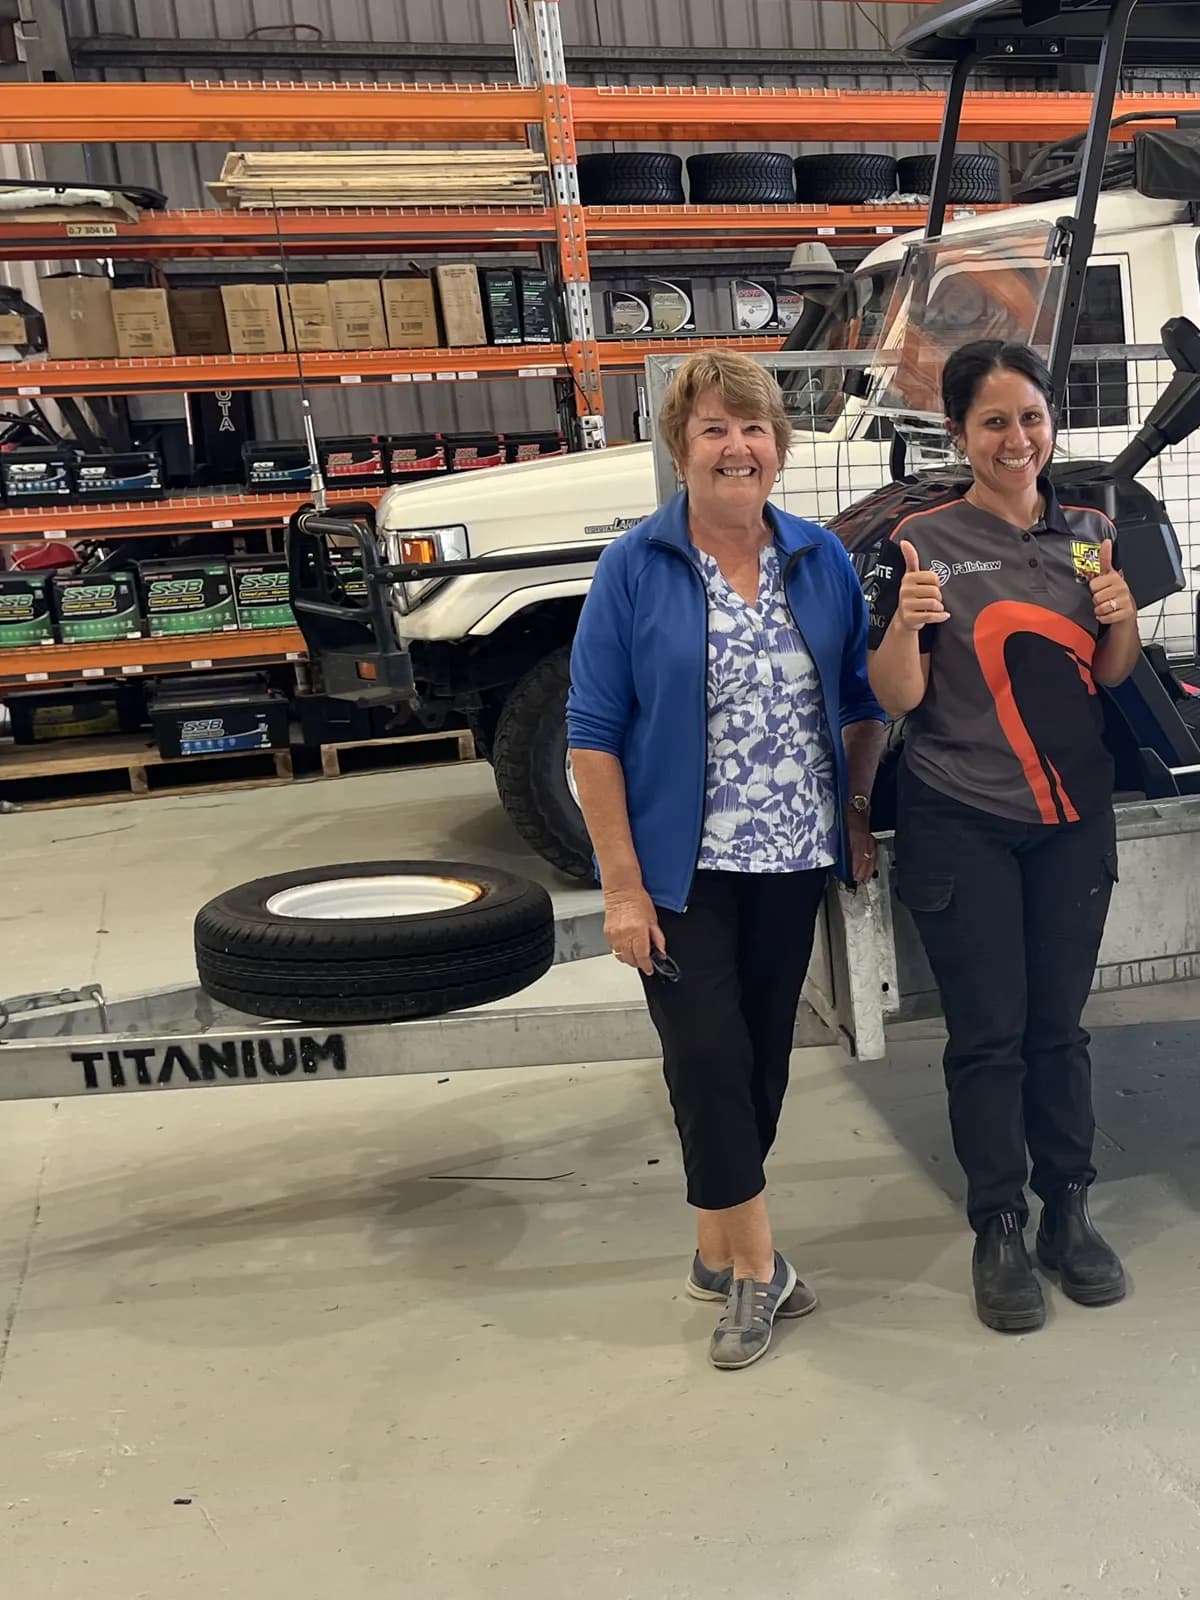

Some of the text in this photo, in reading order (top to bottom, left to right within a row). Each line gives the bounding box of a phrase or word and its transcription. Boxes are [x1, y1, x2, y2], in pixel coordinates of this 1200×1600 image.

[952, 560, 1001, 575] Fallshaw
[62, 584, 116, 602] SSB
[150, 579, 203, 596] SSB
[0, 594, 34, 608] SB
[182, 718, 223, 732] SSB
[71, 1034, 347, 1089] TITANIUM
